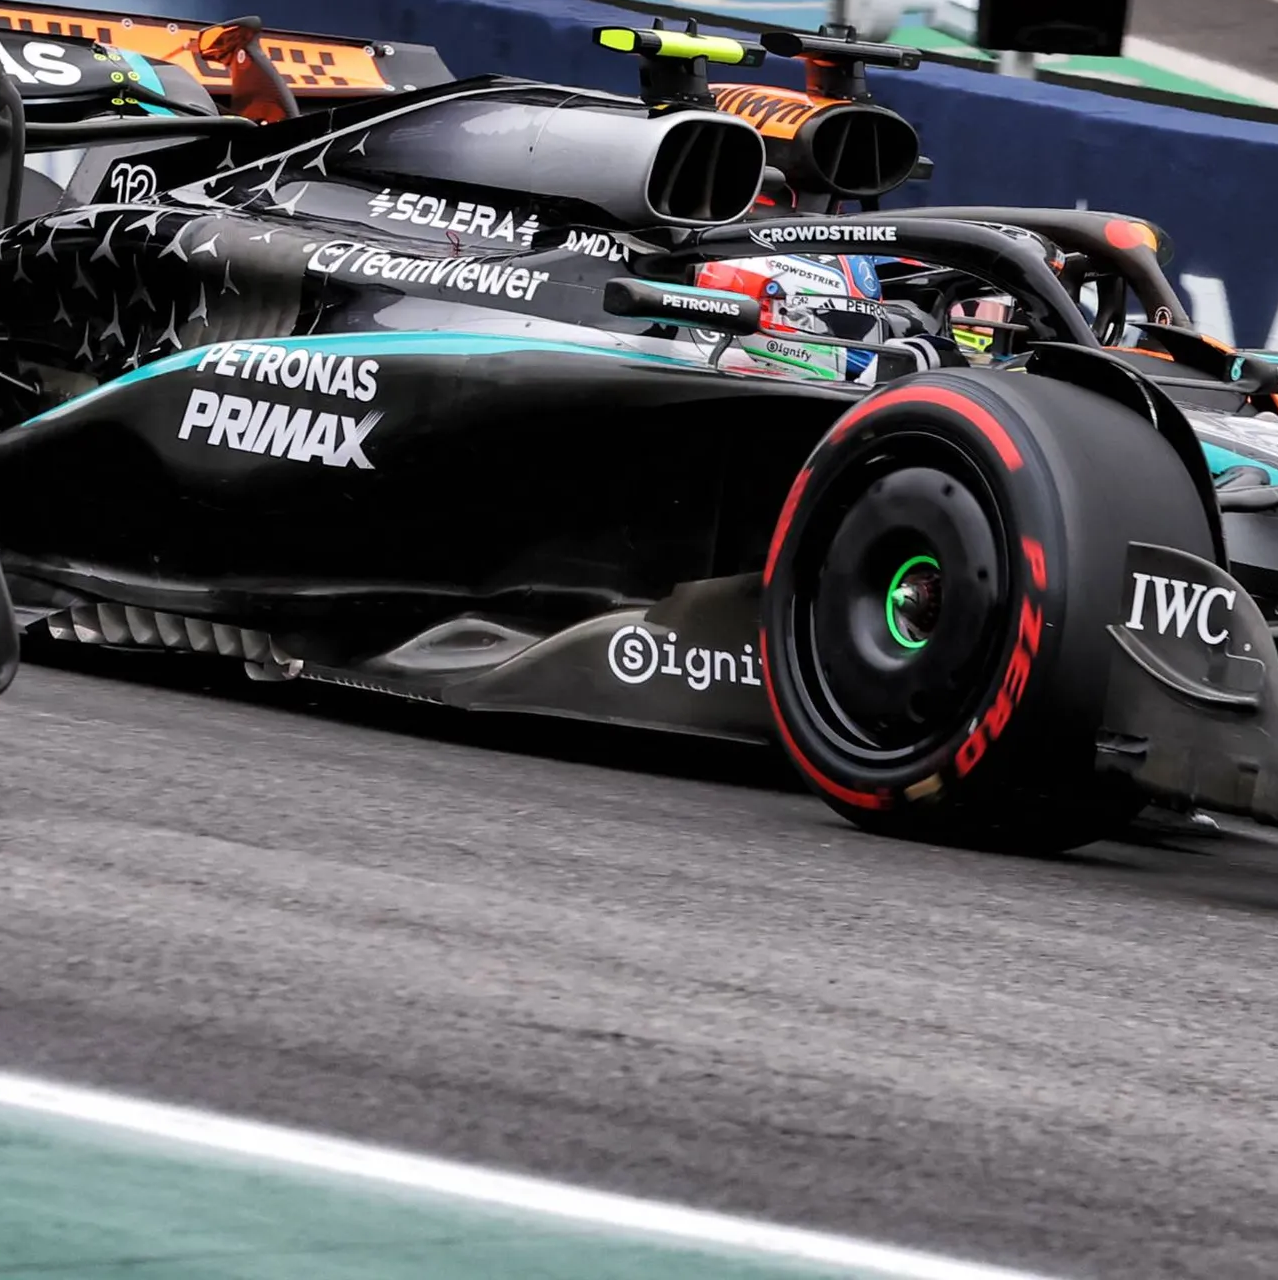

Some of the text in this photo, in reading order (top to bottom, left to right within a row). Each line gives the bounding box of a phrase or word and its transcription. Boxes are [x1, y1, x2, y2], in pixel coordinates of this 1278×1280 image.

[112, 164, 159, 204] 12
[388, 193, 515, 242] SOLERA
[759, 226, 897, 242] CROWDSTRIKE
[558, 230, 611, 258] AMD
[351, 246, 549, 301] TeamViewer
[770, 260, 840, 289] CROWDSTRIKE
[663, 295, 740, 317] PETRONAS
[197, 343, 380, 402] PETRONAS
[178, 391, 385, 469] PRIMAX
[1125, 572, 1235, 646] IWC
